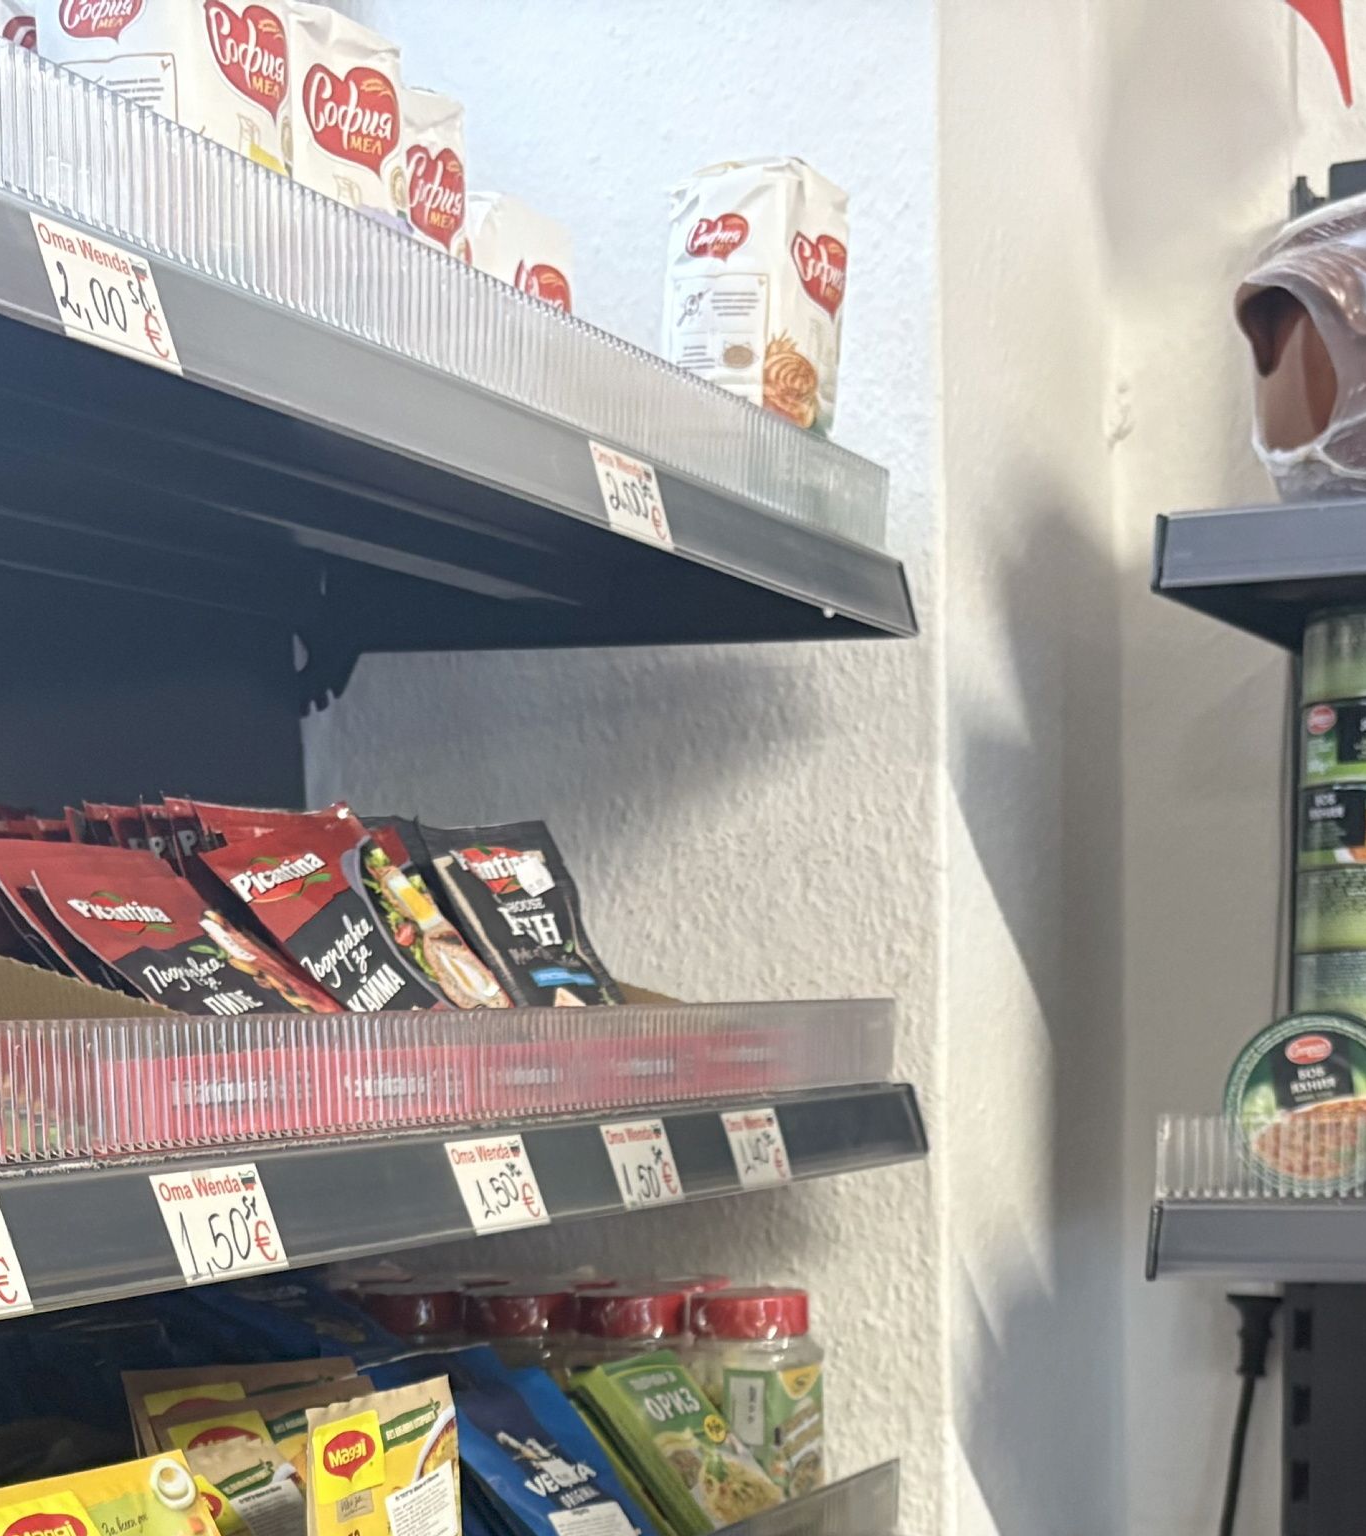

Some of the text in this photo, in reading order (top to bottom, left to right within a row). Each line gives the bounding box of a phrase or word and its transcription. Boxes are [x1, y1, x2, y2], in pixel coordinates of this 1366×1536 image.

[208, 3, 285, 88] София
[252, 74, 281, 98] МЕЛ
[308, 73, 394, 149] София
[350, 135, 382, 156] МЕЛ
[37, 222, 131, 276] Oma Wenda
[56, 260, 170, 359] 2,00 €
[230, 852, 326, 903] Picantina
[67, 899, 172, 924] Picantina
[202, 988, 264, 1017] ПИЛЕ
[346, 963, 406, 1013] КАЙМА
[451, 1143, 511, 1166] Oma Wenda
[159, 1175, 241, 1202] Oma Wenda
[522, 1183, 540, 1217] €
[179, 1207, 277, 1281] 1,50 €
[643, 1387, 701, 1422] ОРИЗ
[327, 1438, 368, 1469] Maggi
